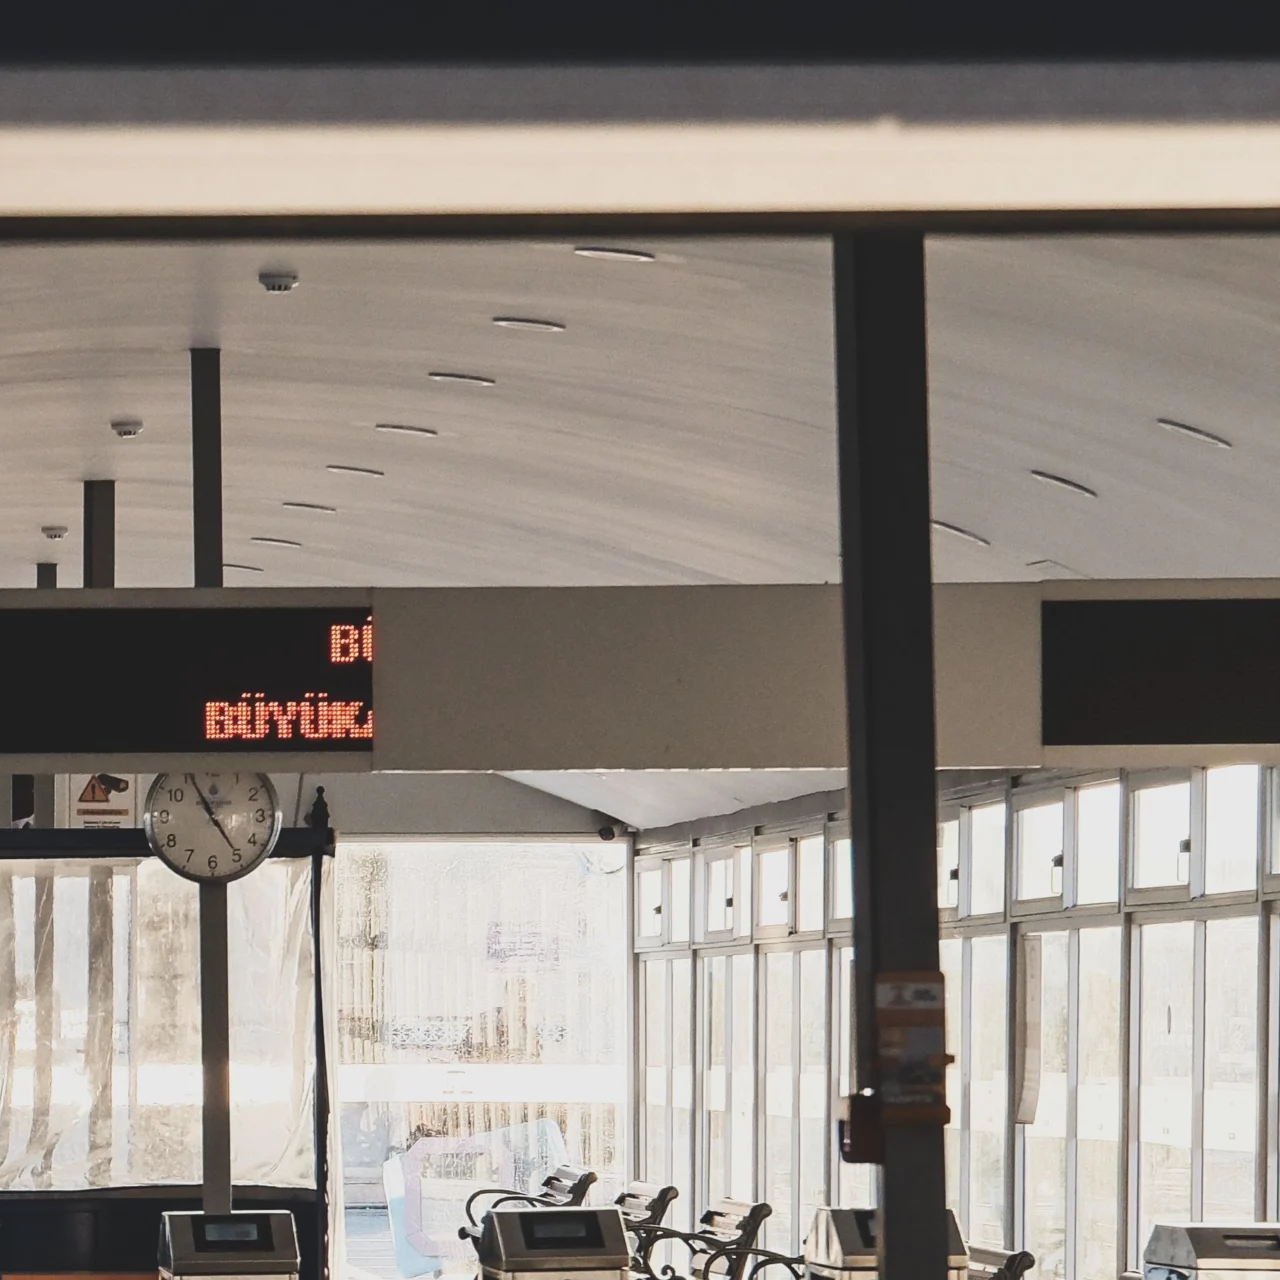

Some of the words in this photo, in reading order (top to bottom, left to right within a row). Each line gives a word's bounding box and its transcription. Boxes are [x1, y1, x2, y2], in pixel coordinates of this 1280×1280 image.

[168, 788, 184, 802] 10
[249, 787, 259, 802] 2
[159, 809, 170, 824] 9
[255, 808, 266, 823] 3
[167, 834, 177, 848] 8
[248, 833, 258, 847] 4
[184, 849, 194, 863] 7
[208, 855, 218, 869] 6
[232, 849, 242, 863] 5
